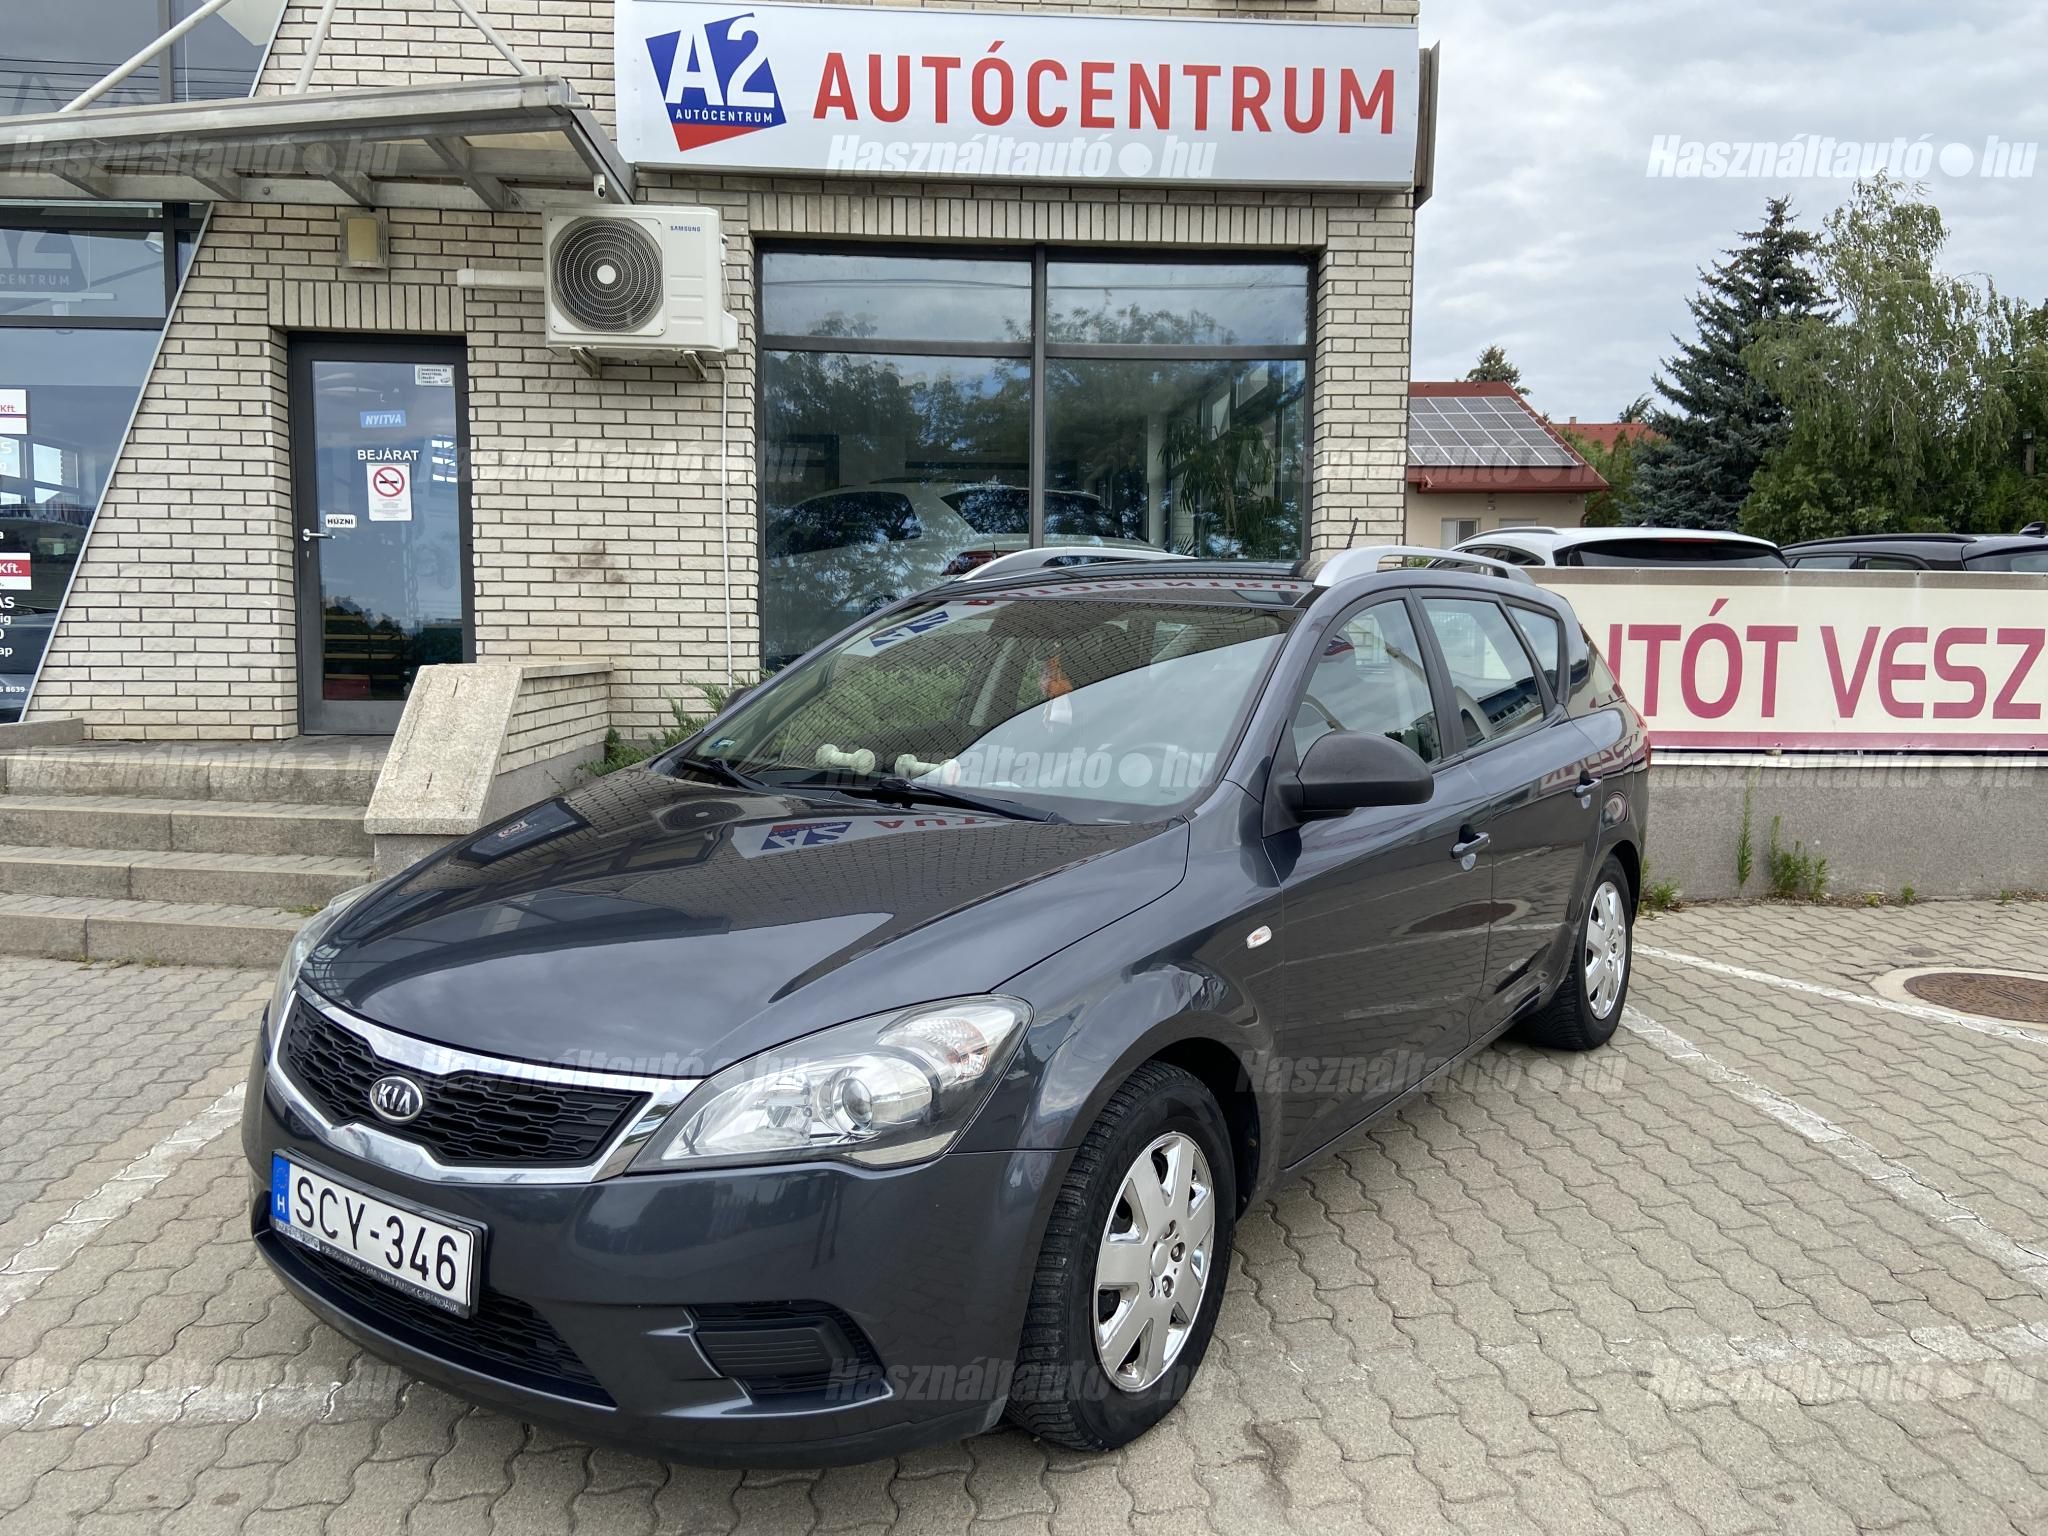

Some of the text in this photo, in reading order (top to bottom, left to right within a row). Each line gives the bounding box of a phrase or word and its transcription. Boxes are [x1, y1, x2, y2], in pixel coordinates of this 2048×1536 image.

[665, 14, 774, 108] A2
[813, 41, 1395, 135] AUTÓCENTRUM
[676, 108, 773, 123] AUTÓCENTRUM
[365, 414, 402, 425] NYITVA
[357, 447, 419, 461] BEJÁRAT
[1819, 626, 2046, 719] VESZ
[377, 1083, 412, 1116] KIA
[276, 1193, 286, 1214] H
[296, 1176, 458, 1291] SCY-346
